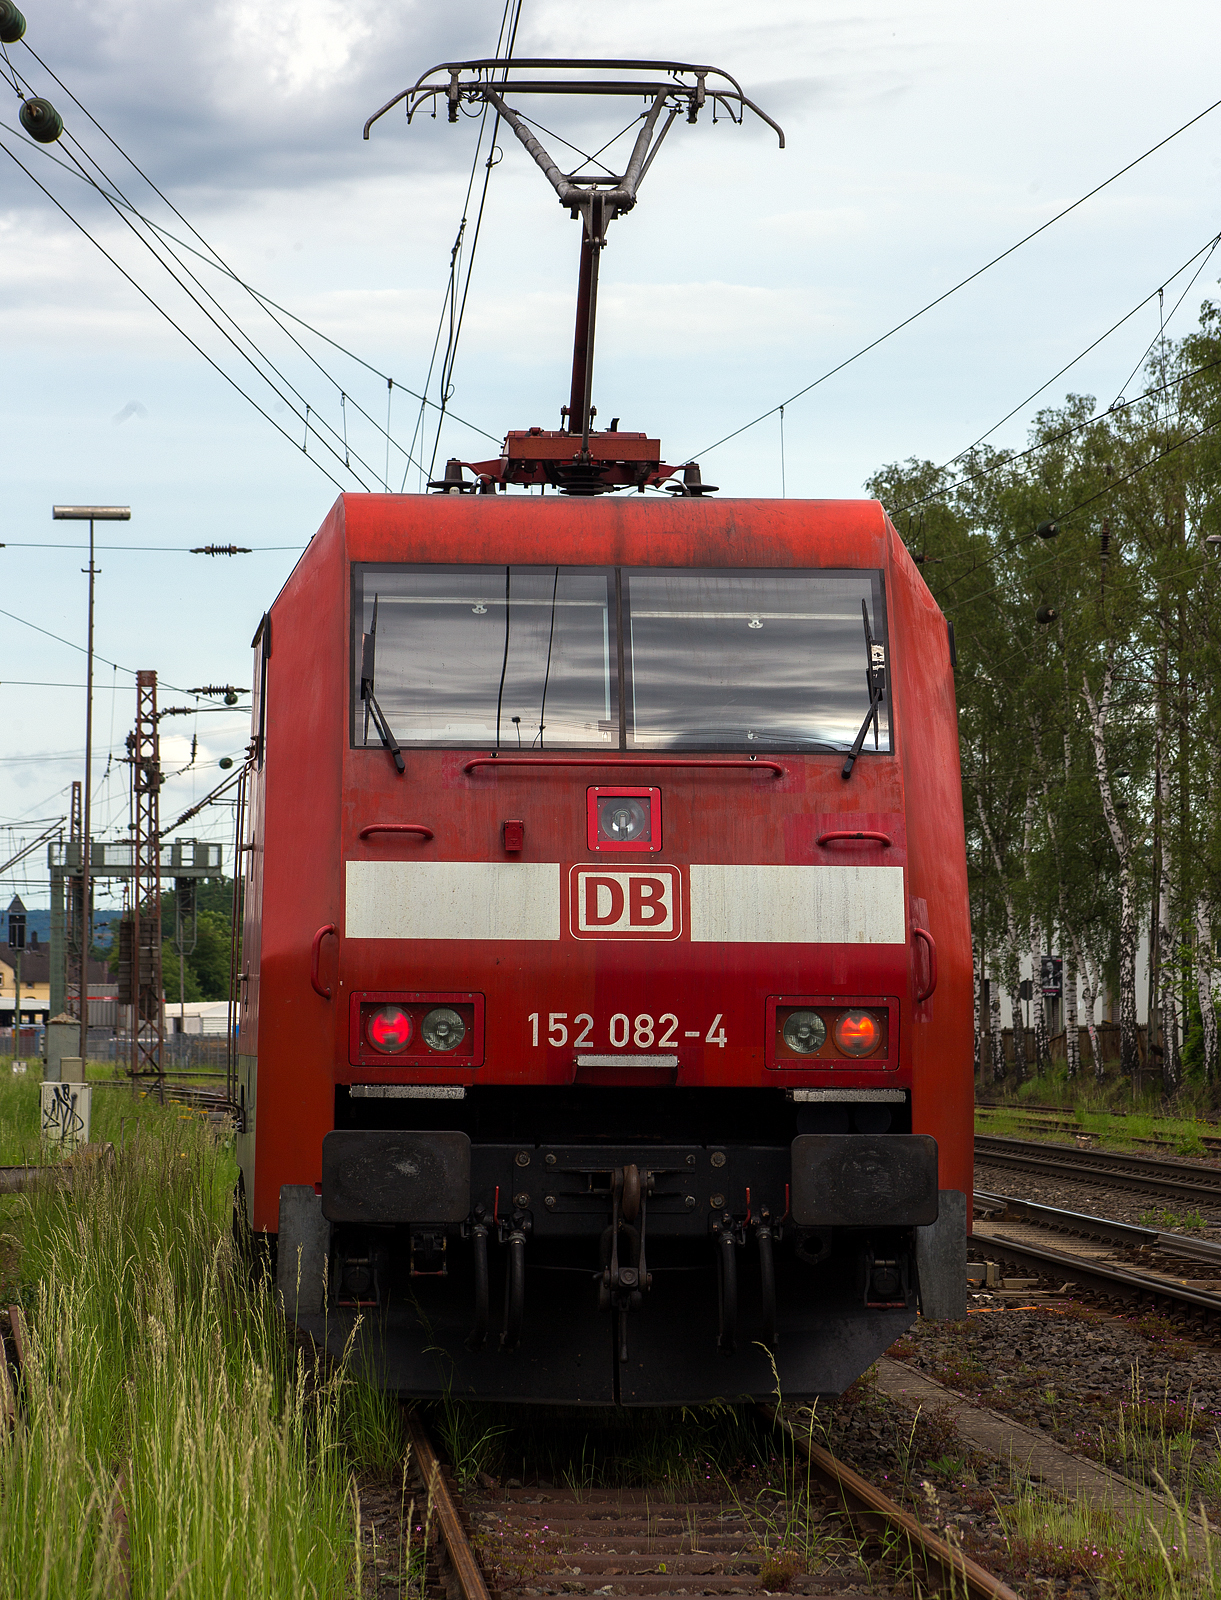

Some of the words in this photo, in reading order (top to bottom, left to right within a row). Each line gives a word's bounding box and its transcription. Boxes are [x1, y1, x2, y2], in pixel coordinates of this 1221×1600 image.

[585, 876, 668, 926] DB
[527, 1012, 595, 1047] 152
[609, 1013, 728, 1048] 082-4
